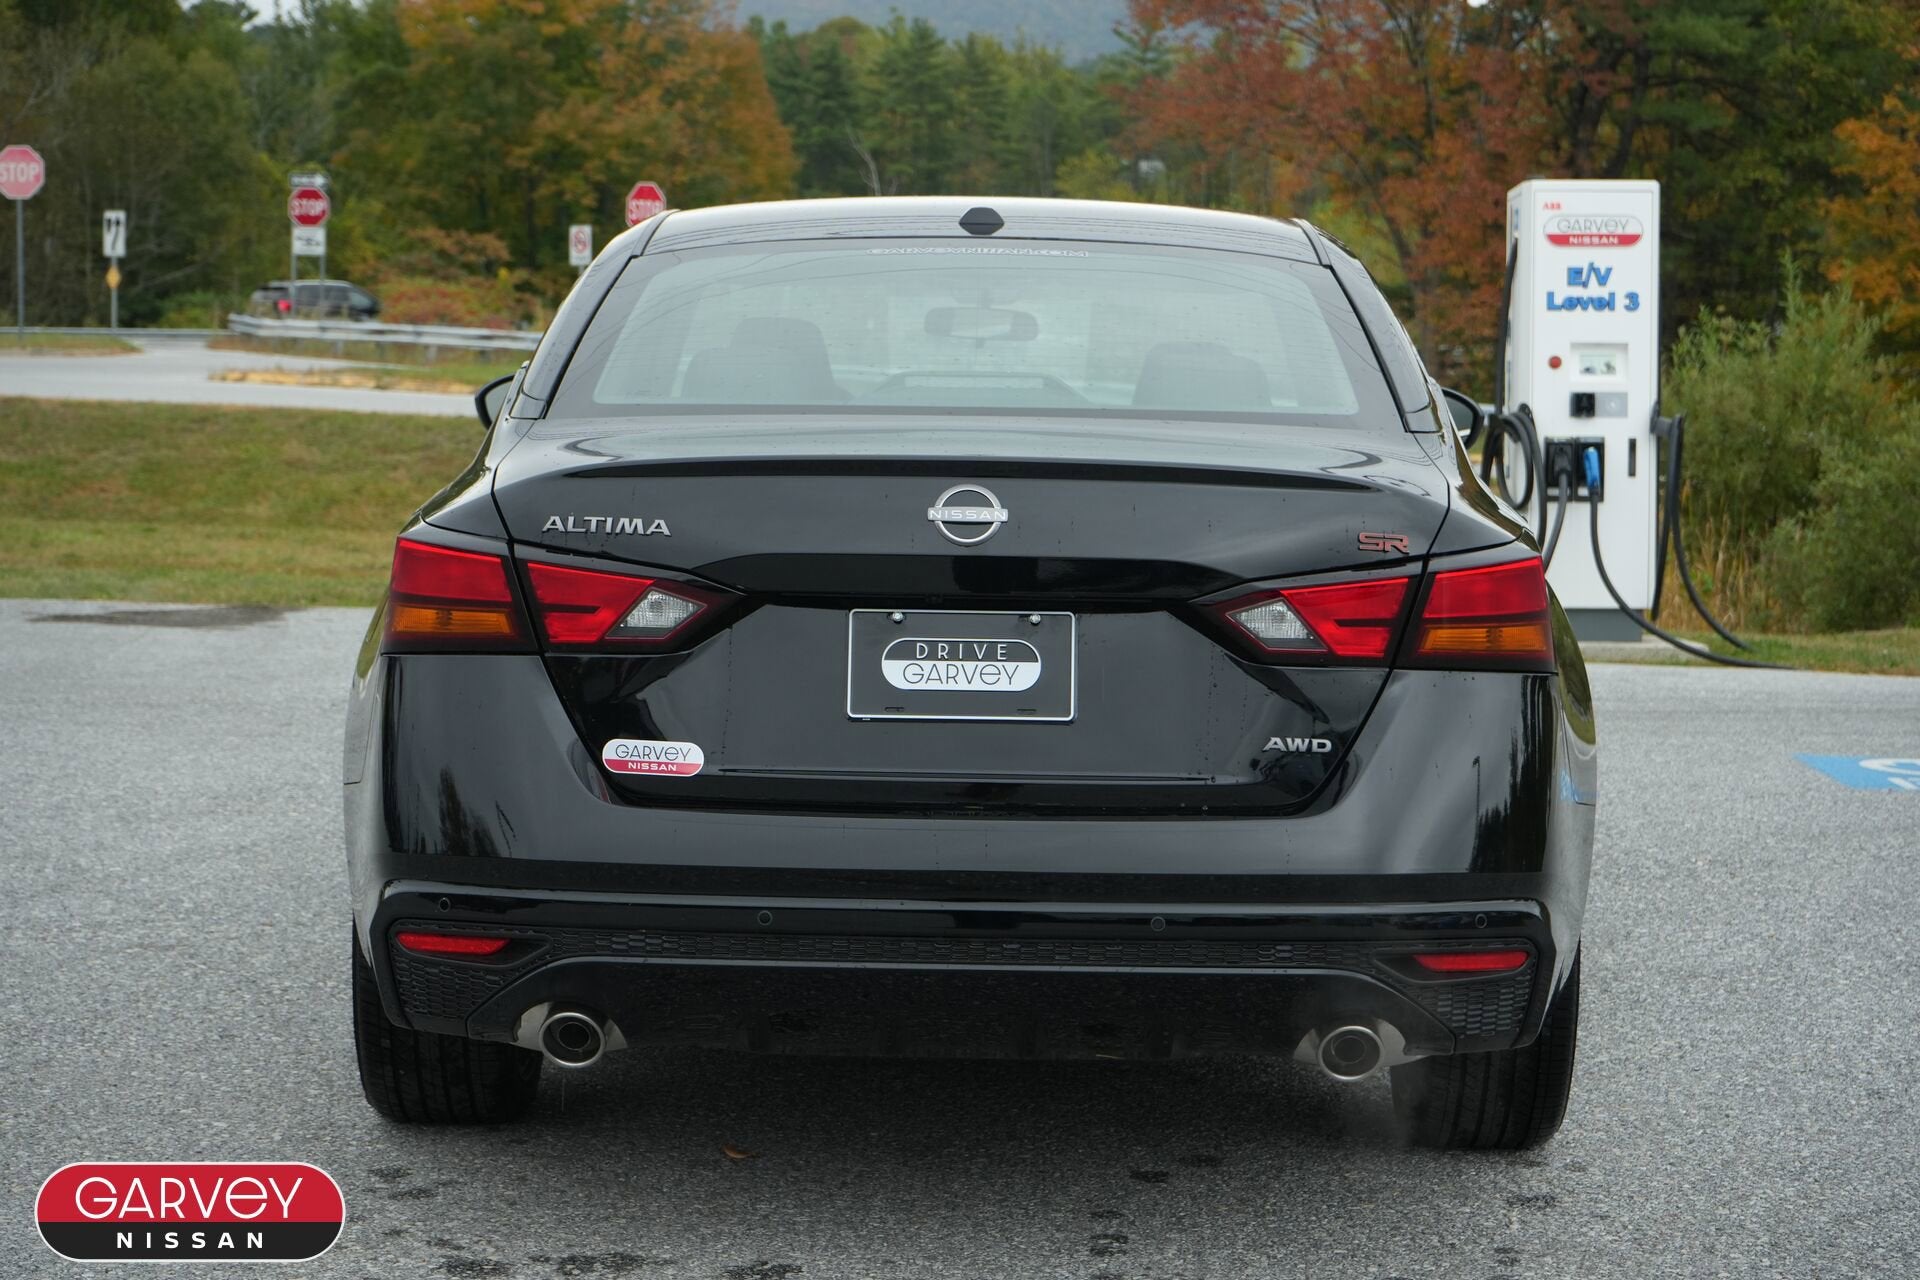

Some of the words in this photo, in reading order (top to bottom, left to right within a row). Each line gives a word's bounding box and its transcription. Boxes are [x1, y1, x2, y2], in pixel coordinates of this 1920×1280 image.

[0, 161, 39, 183] STOP
[291, 198, 326, 216] STOP
[1543, 202, 1561, 210] ABB
[1569, 235, 1619, 245] NISSAN
[1567, 262, 1613, 288] E/V
[1546, 291, 1616, 311] Level
[1624, 292, 1640, 311] 3
[929, 509, 1006, 520] NISSAN
[542, 515, 672, 537] ALTIMA
[1358, 531, 1410, 554] SR
[915, 642, 1008, 660] DRIVE
[1263, 736, 1333, 754] AWD
[628, 762, 678, 771] NISSAN
